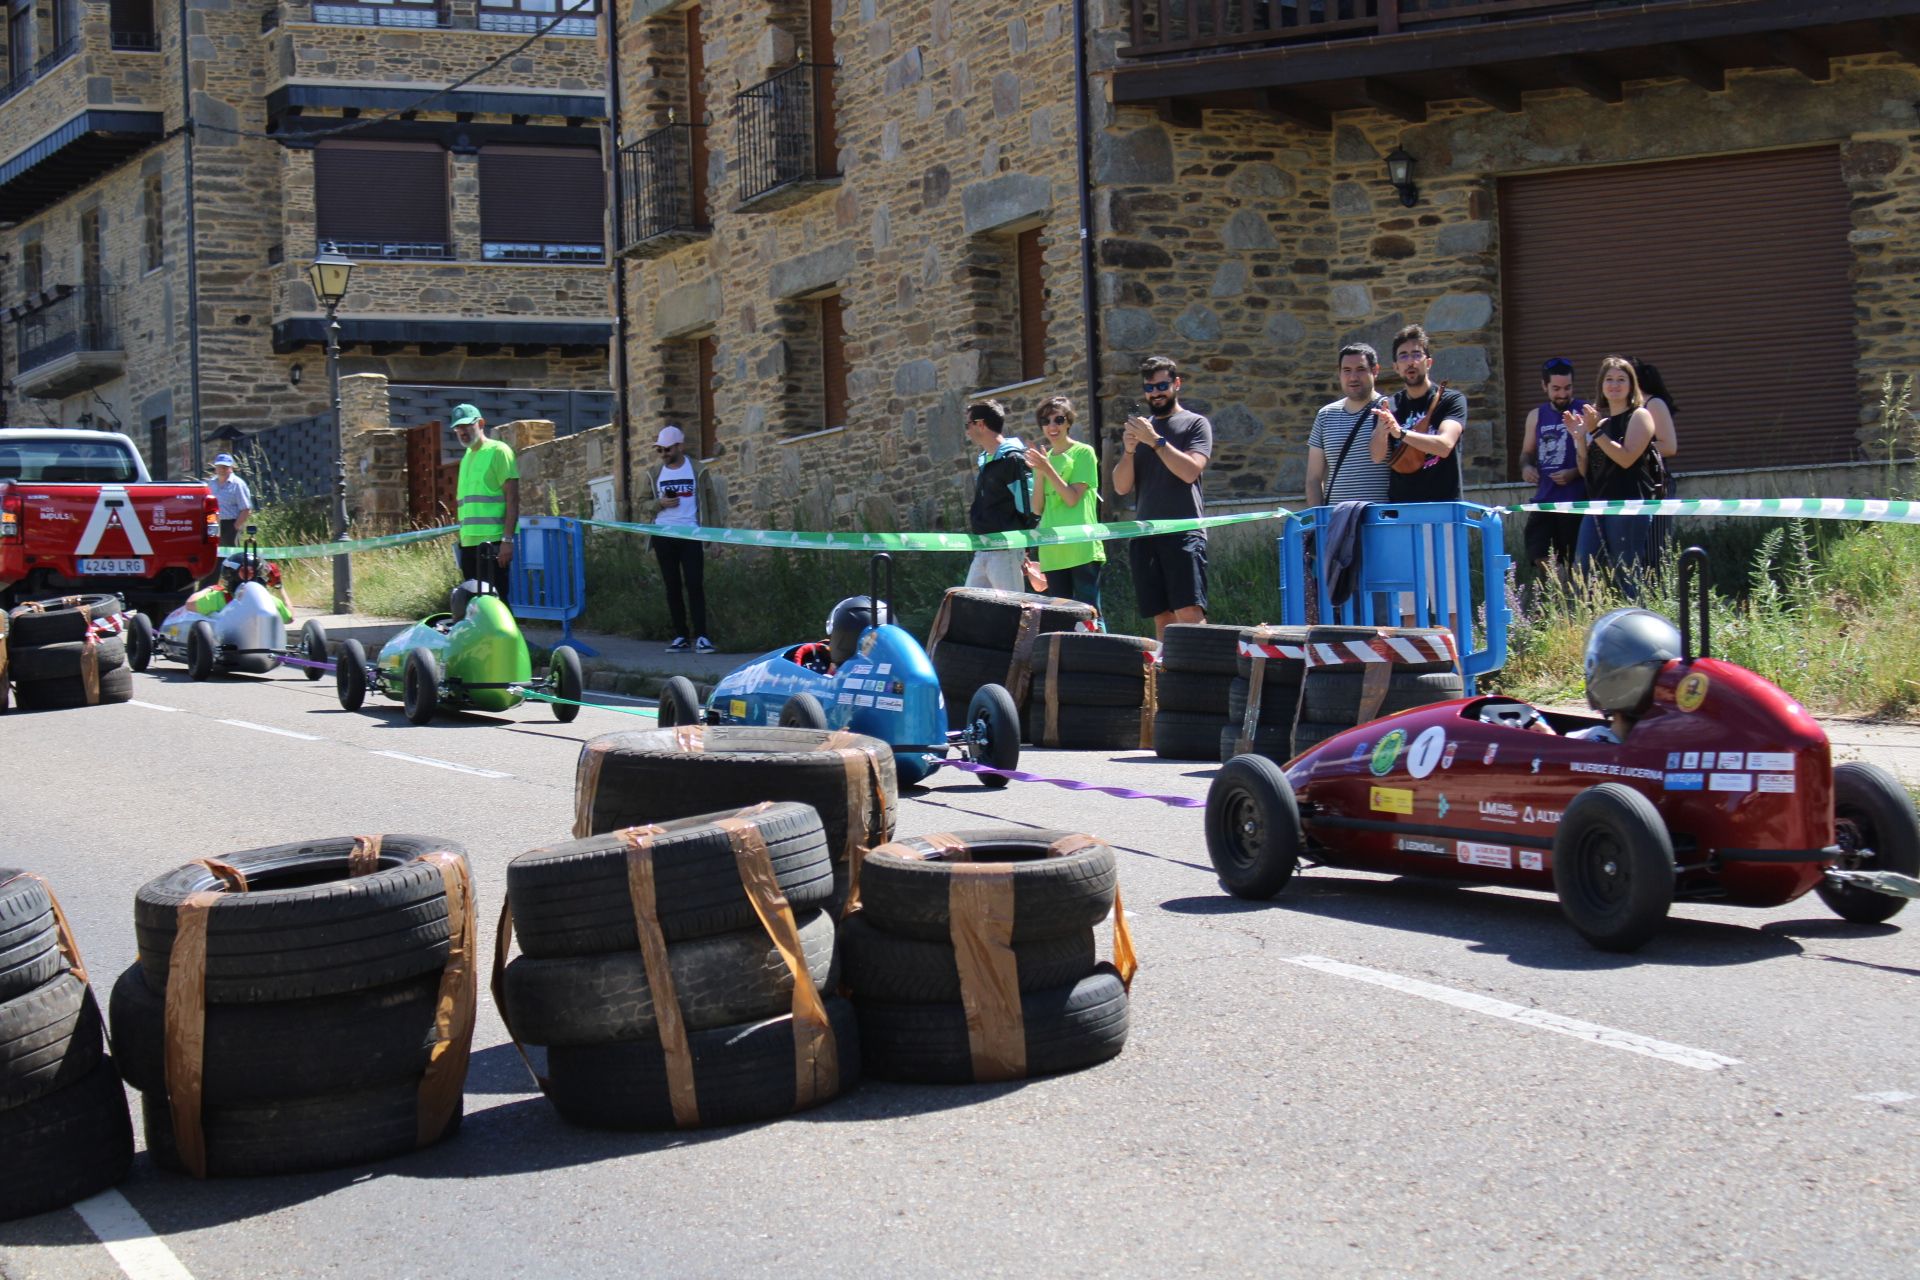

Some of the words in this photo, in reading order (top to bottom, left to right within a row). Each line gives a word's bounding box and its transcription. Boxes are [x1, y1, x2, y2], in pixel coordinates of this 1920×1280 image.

[86, 561, 114, 571] 4249
[119, 561, 140, 571] LRG
[1419, 736, 1434, 766] 1
[1570, 762, 1608, 773] VALVERDE
[1609, 765, 1620, 775] DE
[1621, 767, 1663, 780] LUCERNA
